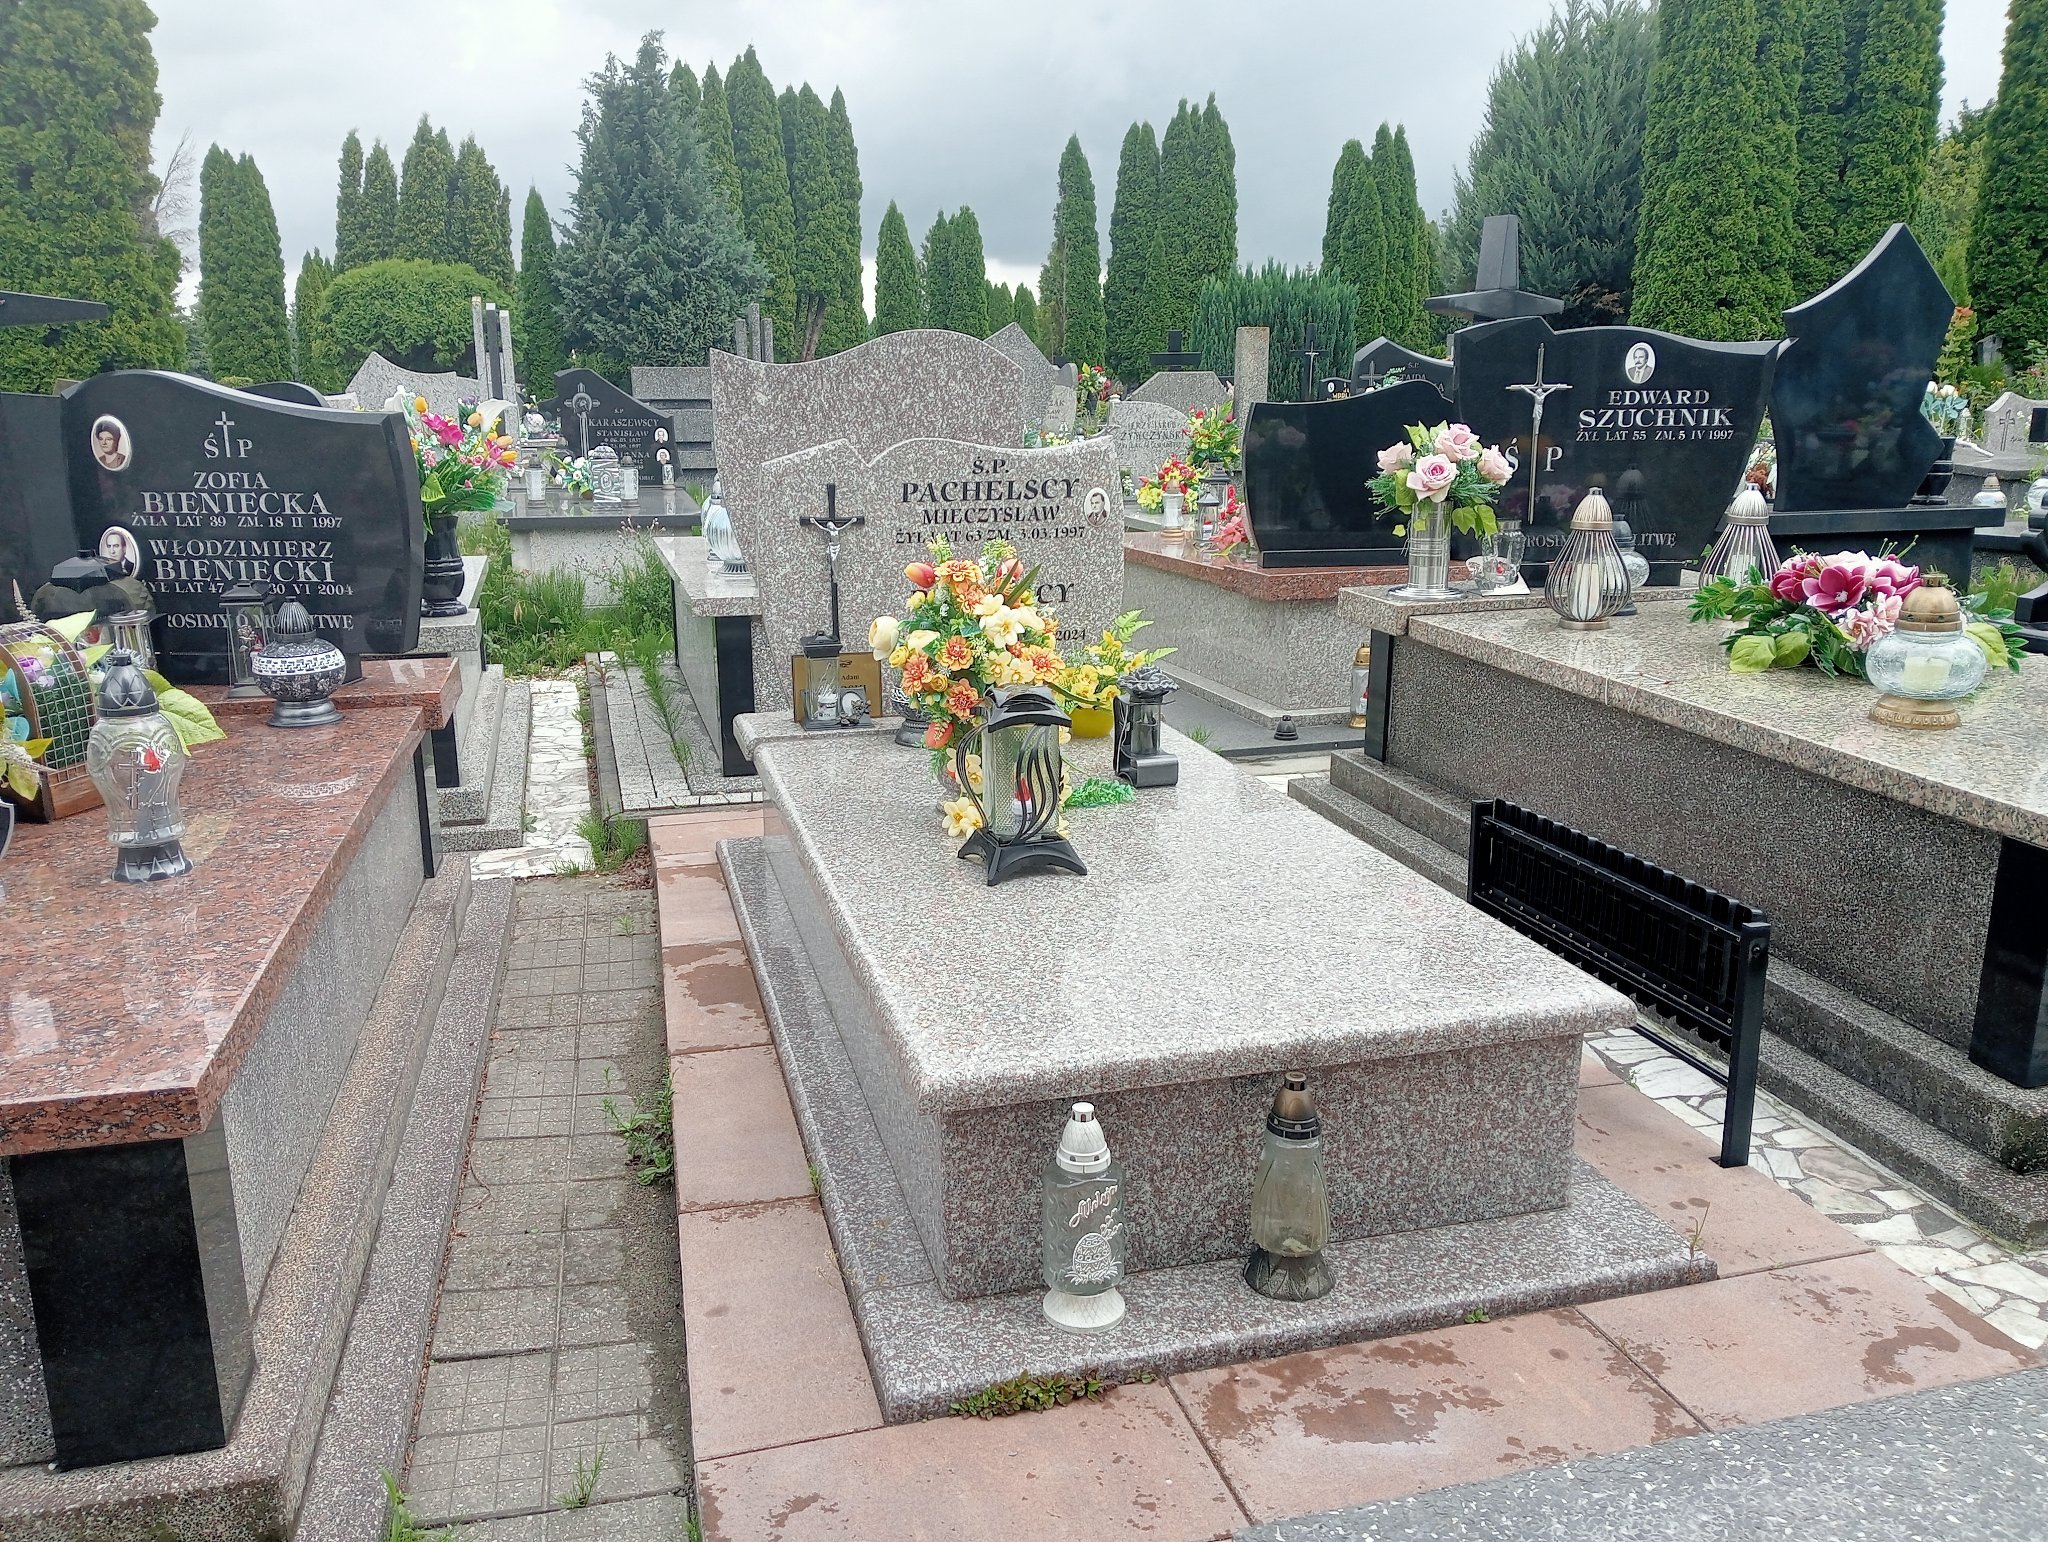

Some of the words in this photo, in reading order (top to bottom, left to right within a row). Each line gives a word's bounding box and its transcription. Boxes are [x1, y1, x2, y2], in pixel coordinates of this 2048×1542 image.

[1608, 389, 1710, 406] EDWARD
[1578, 408, 1734, 429] SZUCHNIK
[1605, 430, 1629, 441] LAT
[1632, 430, 1647, 441] 55
[1654, 430, 1676, 441] ZM.
[1678, 430, 1686, 441] 5
[1690, 430, 1706, 440] IV
[1708, 429, 1734, 440] 1997
[204, 433, 219, 459] Ś
[236, 438, 253, 458] P
[1504, 437, 1520, 473] Ś
[1543, 446, 1564, 472] P
[193, 471, 270, 490] ZOFIA
[902, 478, 1080, 503] PACHELSCY
[140, 491, 332, 515] BIENIECKA
[175, 516, 203, 527] LAT
[209, 515, 226, 527] 39
[237, 516, 263, 528] ZM.
[268, 516, 284, 528] 18
[312, 517, 343, 529] 1997
[965, 530, 982, 542] 63
[1019, 526, 1085, 540] 3.03.1997
[148, 539, 334, 558] WŁODZIMIERZ
[154, 559, 335, 583] BIENIECKI
[175, 582, 204, 593] LAT
[208, 582, 225, 594] 47
[292, 584, 311, 595] VI
[317, 584, 354, 596] 2004
[168, 613, 230, 628] ROSIMY
